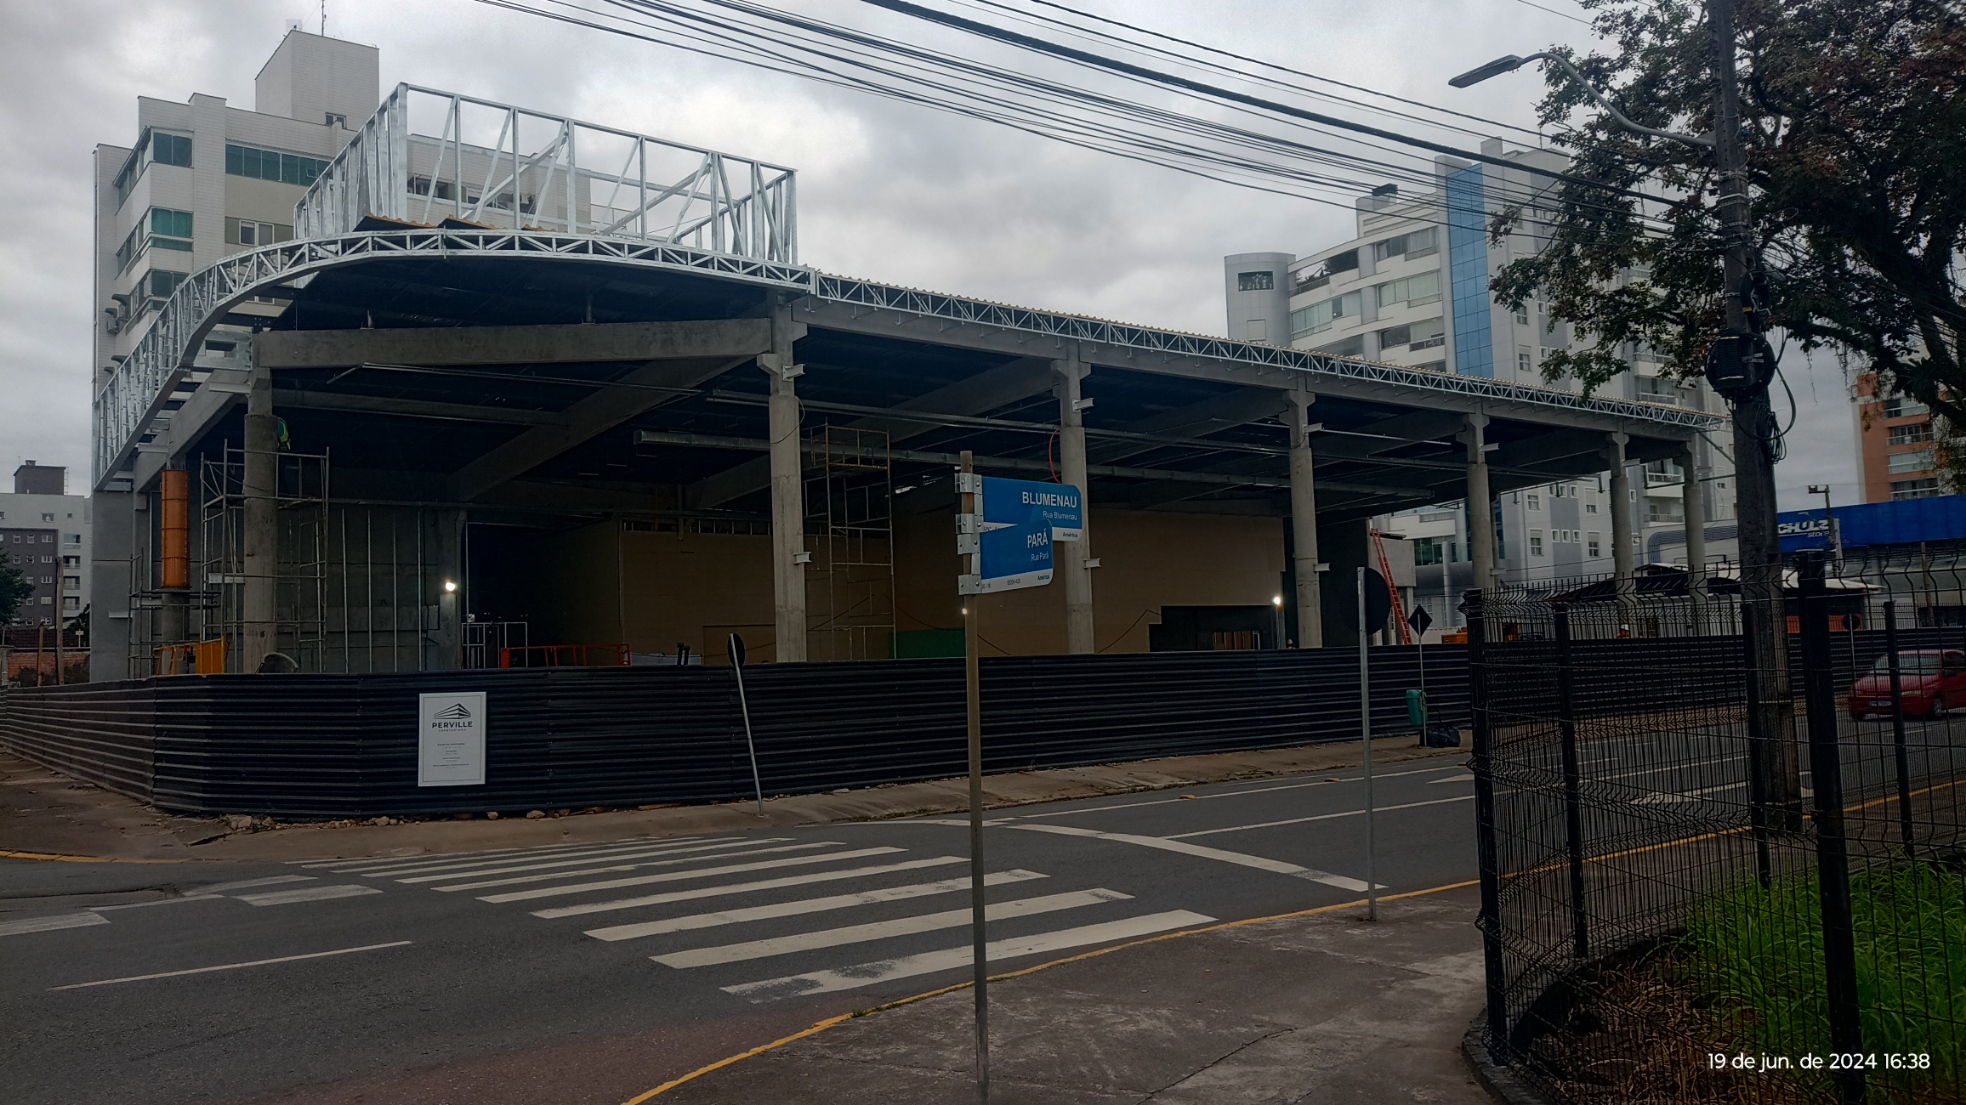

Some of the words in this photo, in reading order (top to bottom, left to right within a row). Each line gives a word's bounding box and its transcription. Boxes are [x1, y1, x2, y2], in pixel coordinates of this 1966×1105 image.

[1022, 491, 1077, 508] BLUMENAU
[1042, 510, 1053, 519] Rua
[1054, 511, 1078, 521] Blumenau
[1778, 519, 1829, 534] CHULZ
[1027, 528, 1048, 549] PARÁ
[1031, 553, 1039, 561] Rua
[432, 721, 473, 729] PERVILLE
